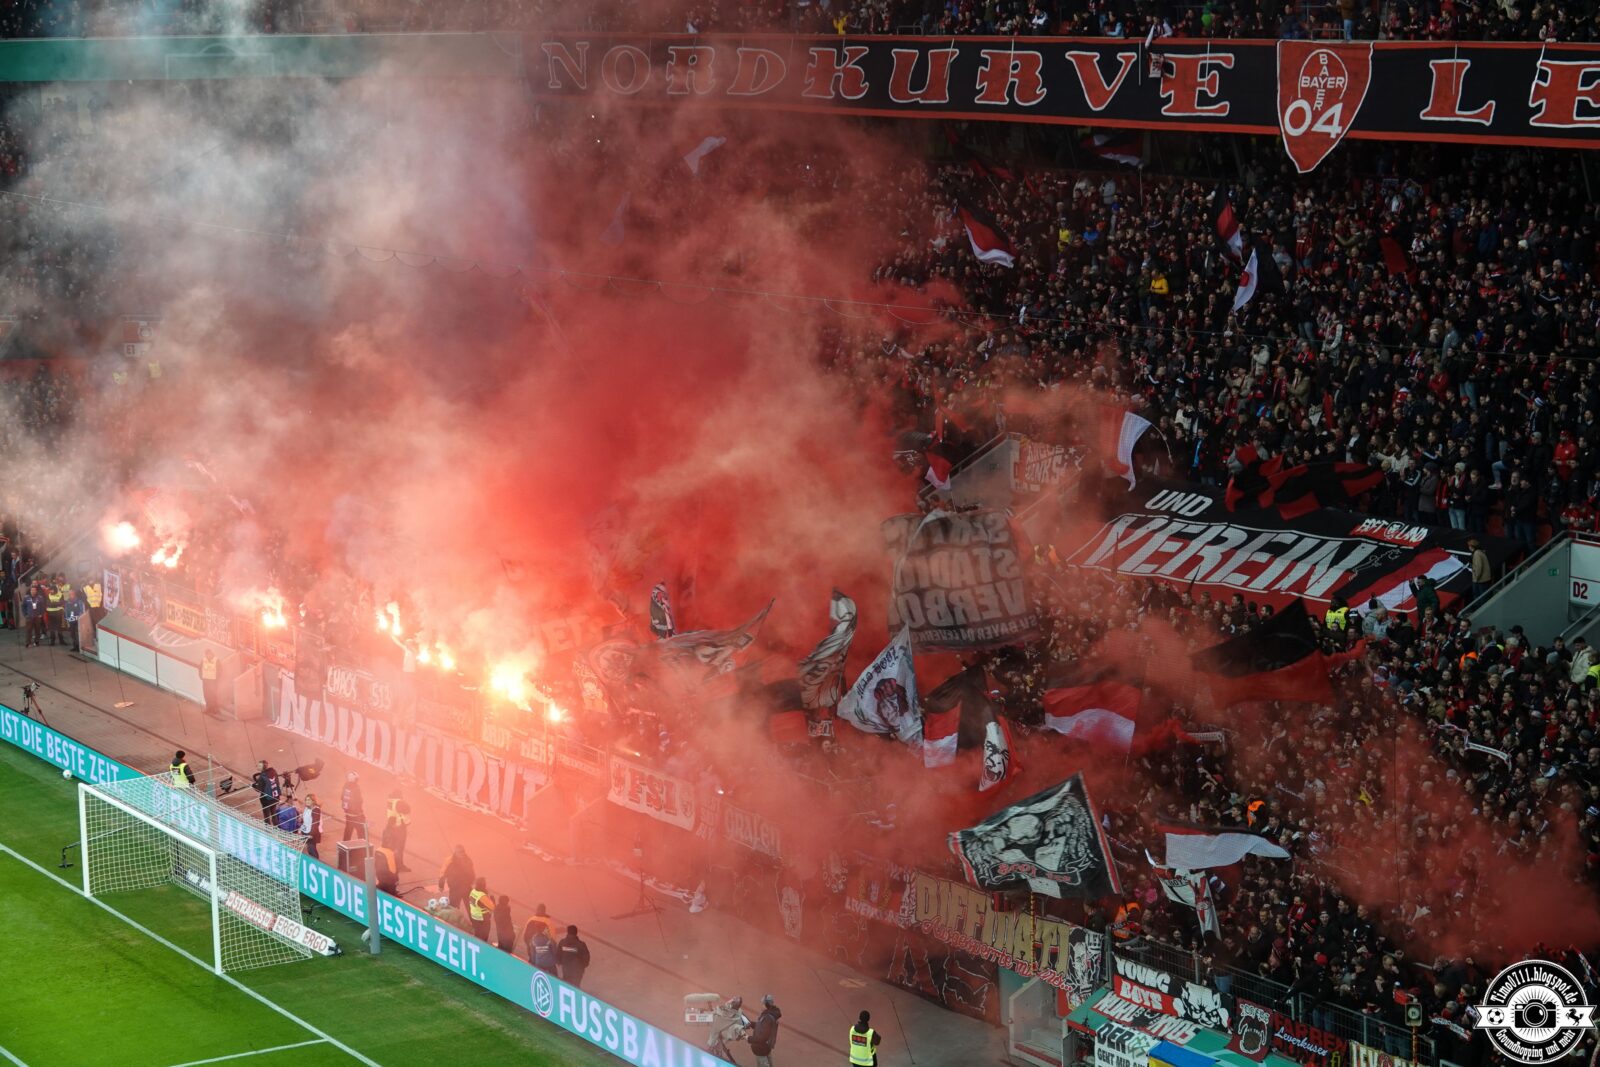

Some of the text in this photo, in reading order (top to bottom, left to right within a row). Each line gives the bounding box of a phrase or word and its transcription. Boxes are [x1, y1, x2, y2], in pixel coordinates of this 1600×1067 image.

[541, 41, 1235, 117] NORDKURVE
[1301, 76, 1344, 89] BAYER
[1284, 99, 1344, 139] 04
[1144, 489, 1213, 517] UND
[1084, 514, 1377, 598] VEREIN
[1572, 581, 1588, 600] D2
[0, 708, 20, 742] IST
[21, 721, 44, 754] DIE
[46, 731, 86, 777] BESTE
[276, 917, 329, 950] ERGO ERGO
[302, 858, 330, 899] IST
[333, 876, 365, 919] DIE
[434, 922, 486, 981] ZEIT.
[1120, 979, 1163, 1010] BOYS
[1096, 1021, 1133, 1052] DER
[1273, 1025, 1329, 1057] Leverkusen
